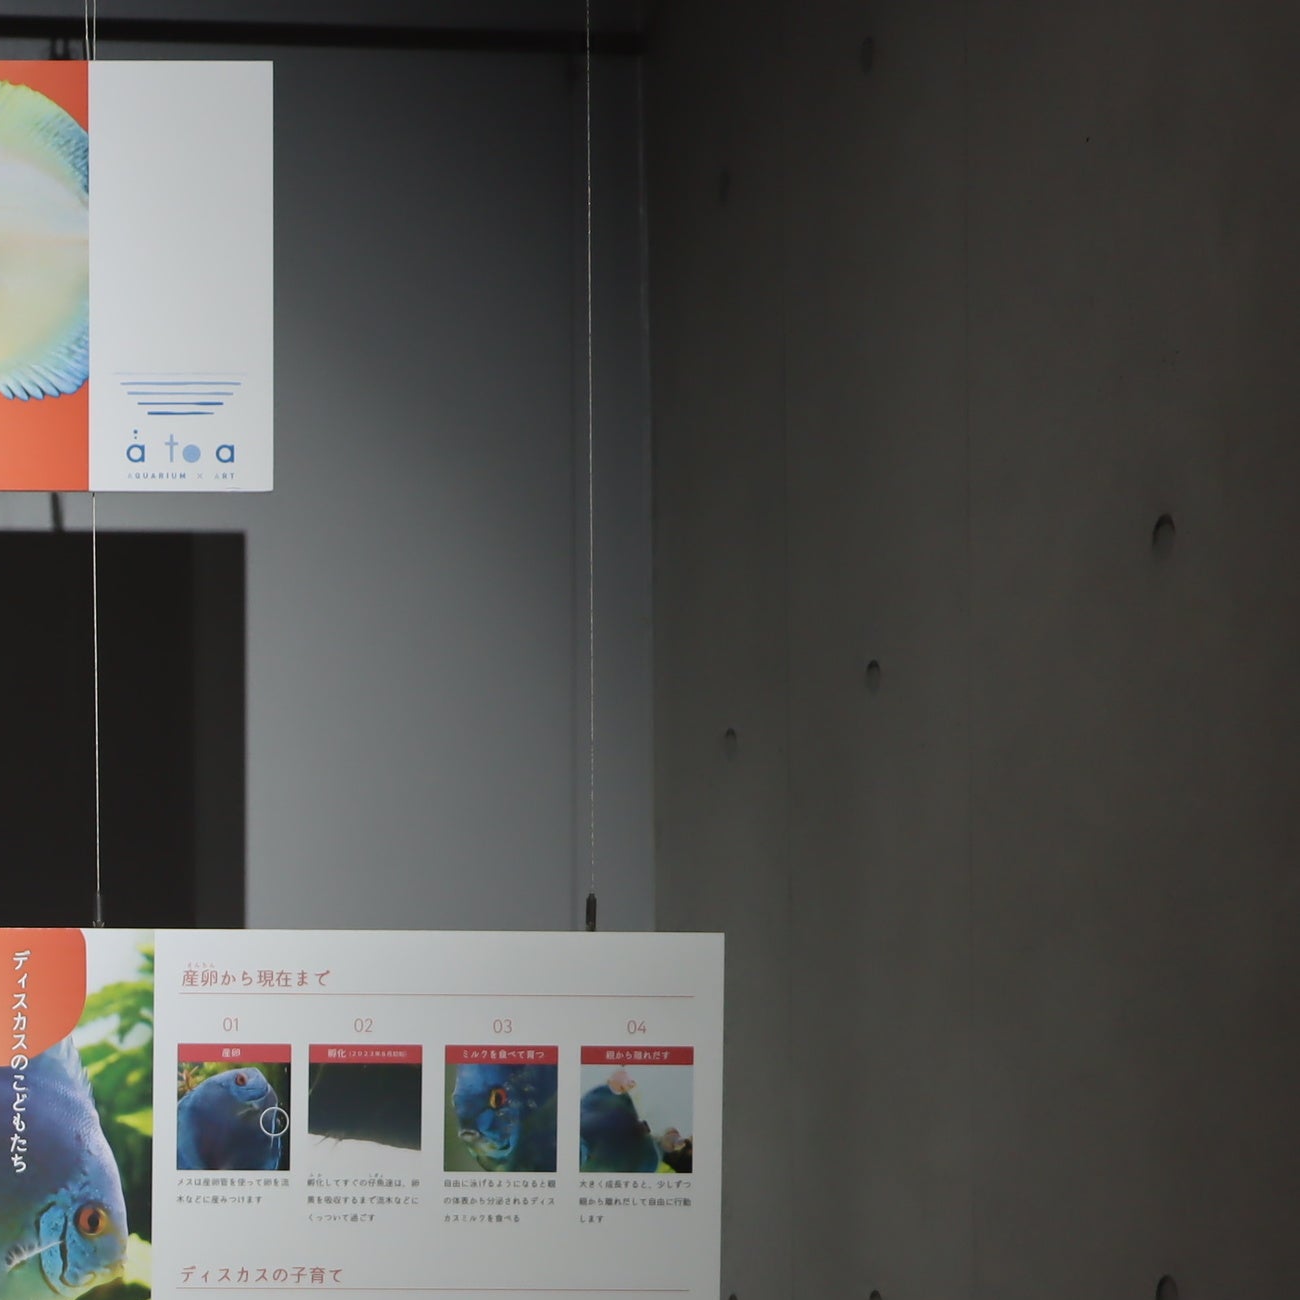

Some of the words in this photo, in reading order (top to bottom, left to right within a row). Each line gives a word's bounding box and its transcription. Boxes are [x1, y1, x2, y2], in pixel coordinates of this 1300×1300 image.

[127, 472, 186, 480] AQUARIUM
[182, 969, 331, 987] 産卵から現在まで
[222, 1017, 239, 1032] 01
[354, 1018, 373, 1033] 02
[493, 1019, 513, 1034] 03
[627, 1020, 647, 1034] 04
[221, 1048, 241, 1058] 産卵
[462, 1049, 545, 1059] ミルクを食べて育つ
[10, 949, 32, 1175] ディスカスのこどもたち
[176, 1195, 263, 1204] 木などに産みつけます
[308, 1213, 376, 1222] くっついて過ごす
[443, 1214, 521, 1223] カスミルクを食べる
[579, 1214, 604, 1224] します
[180, 1265, 343, 1284] ディスカスの子育て
